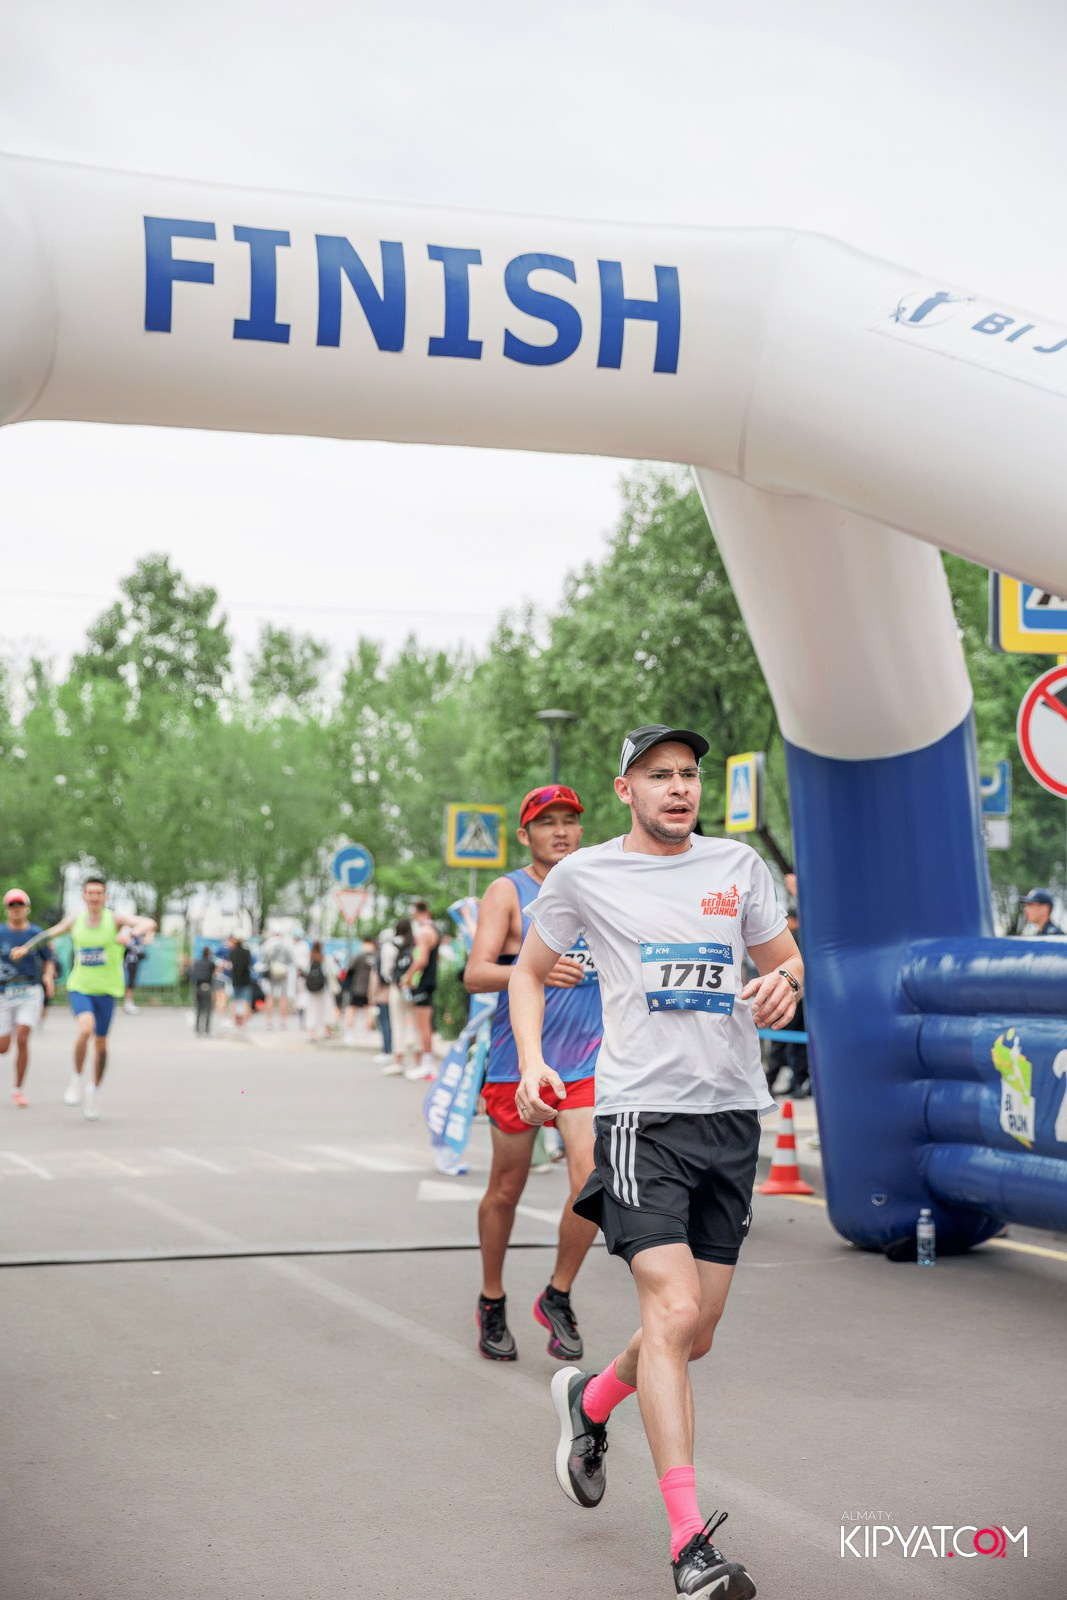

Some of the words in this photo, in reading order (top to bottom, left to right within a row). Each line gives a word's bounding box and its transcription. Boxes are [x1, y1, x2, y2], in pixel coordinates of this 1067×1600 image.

[143, 215, 681, 375] FINISH
[701, 898, 737, 908] БЕГОВАЯ
[703, 907, 738, 918] КУЗНИЦА
[645, 946, 654, 955] 5
[655, 947, 670, 955] KM
[660, 963, 725, 990] 1713
